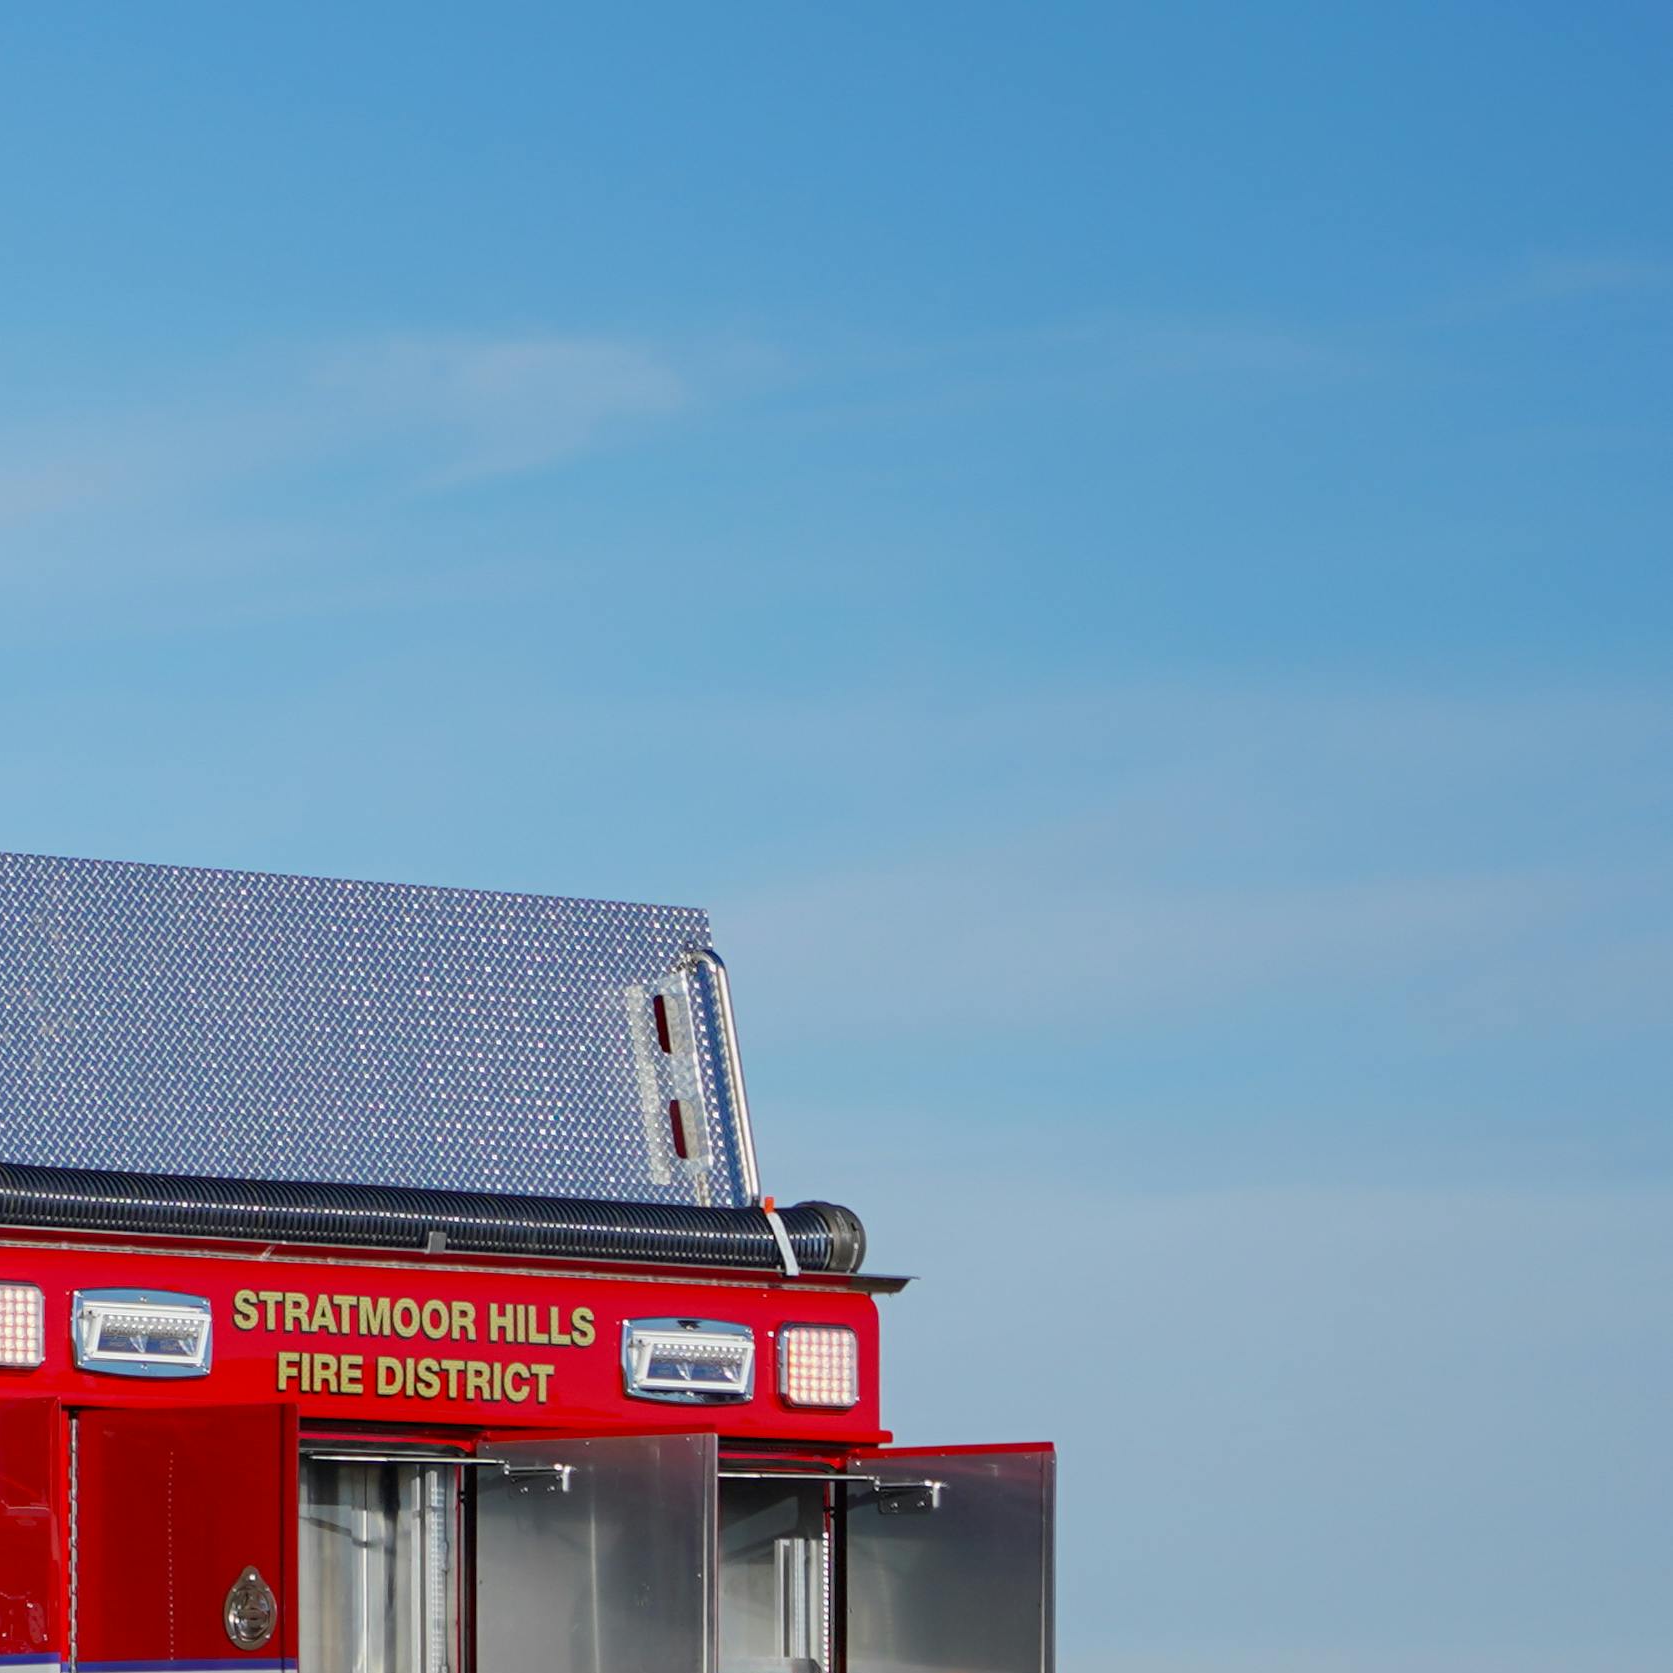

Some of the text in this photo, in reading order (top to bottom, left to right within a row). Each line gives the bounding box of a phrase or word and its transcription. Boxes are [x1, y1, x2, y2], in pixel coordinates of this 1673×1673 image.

[233, 1289, 596, 1347] STRATMOOR HILLS
[277, 1352, 555, 1403] FIRE DISTRICT
